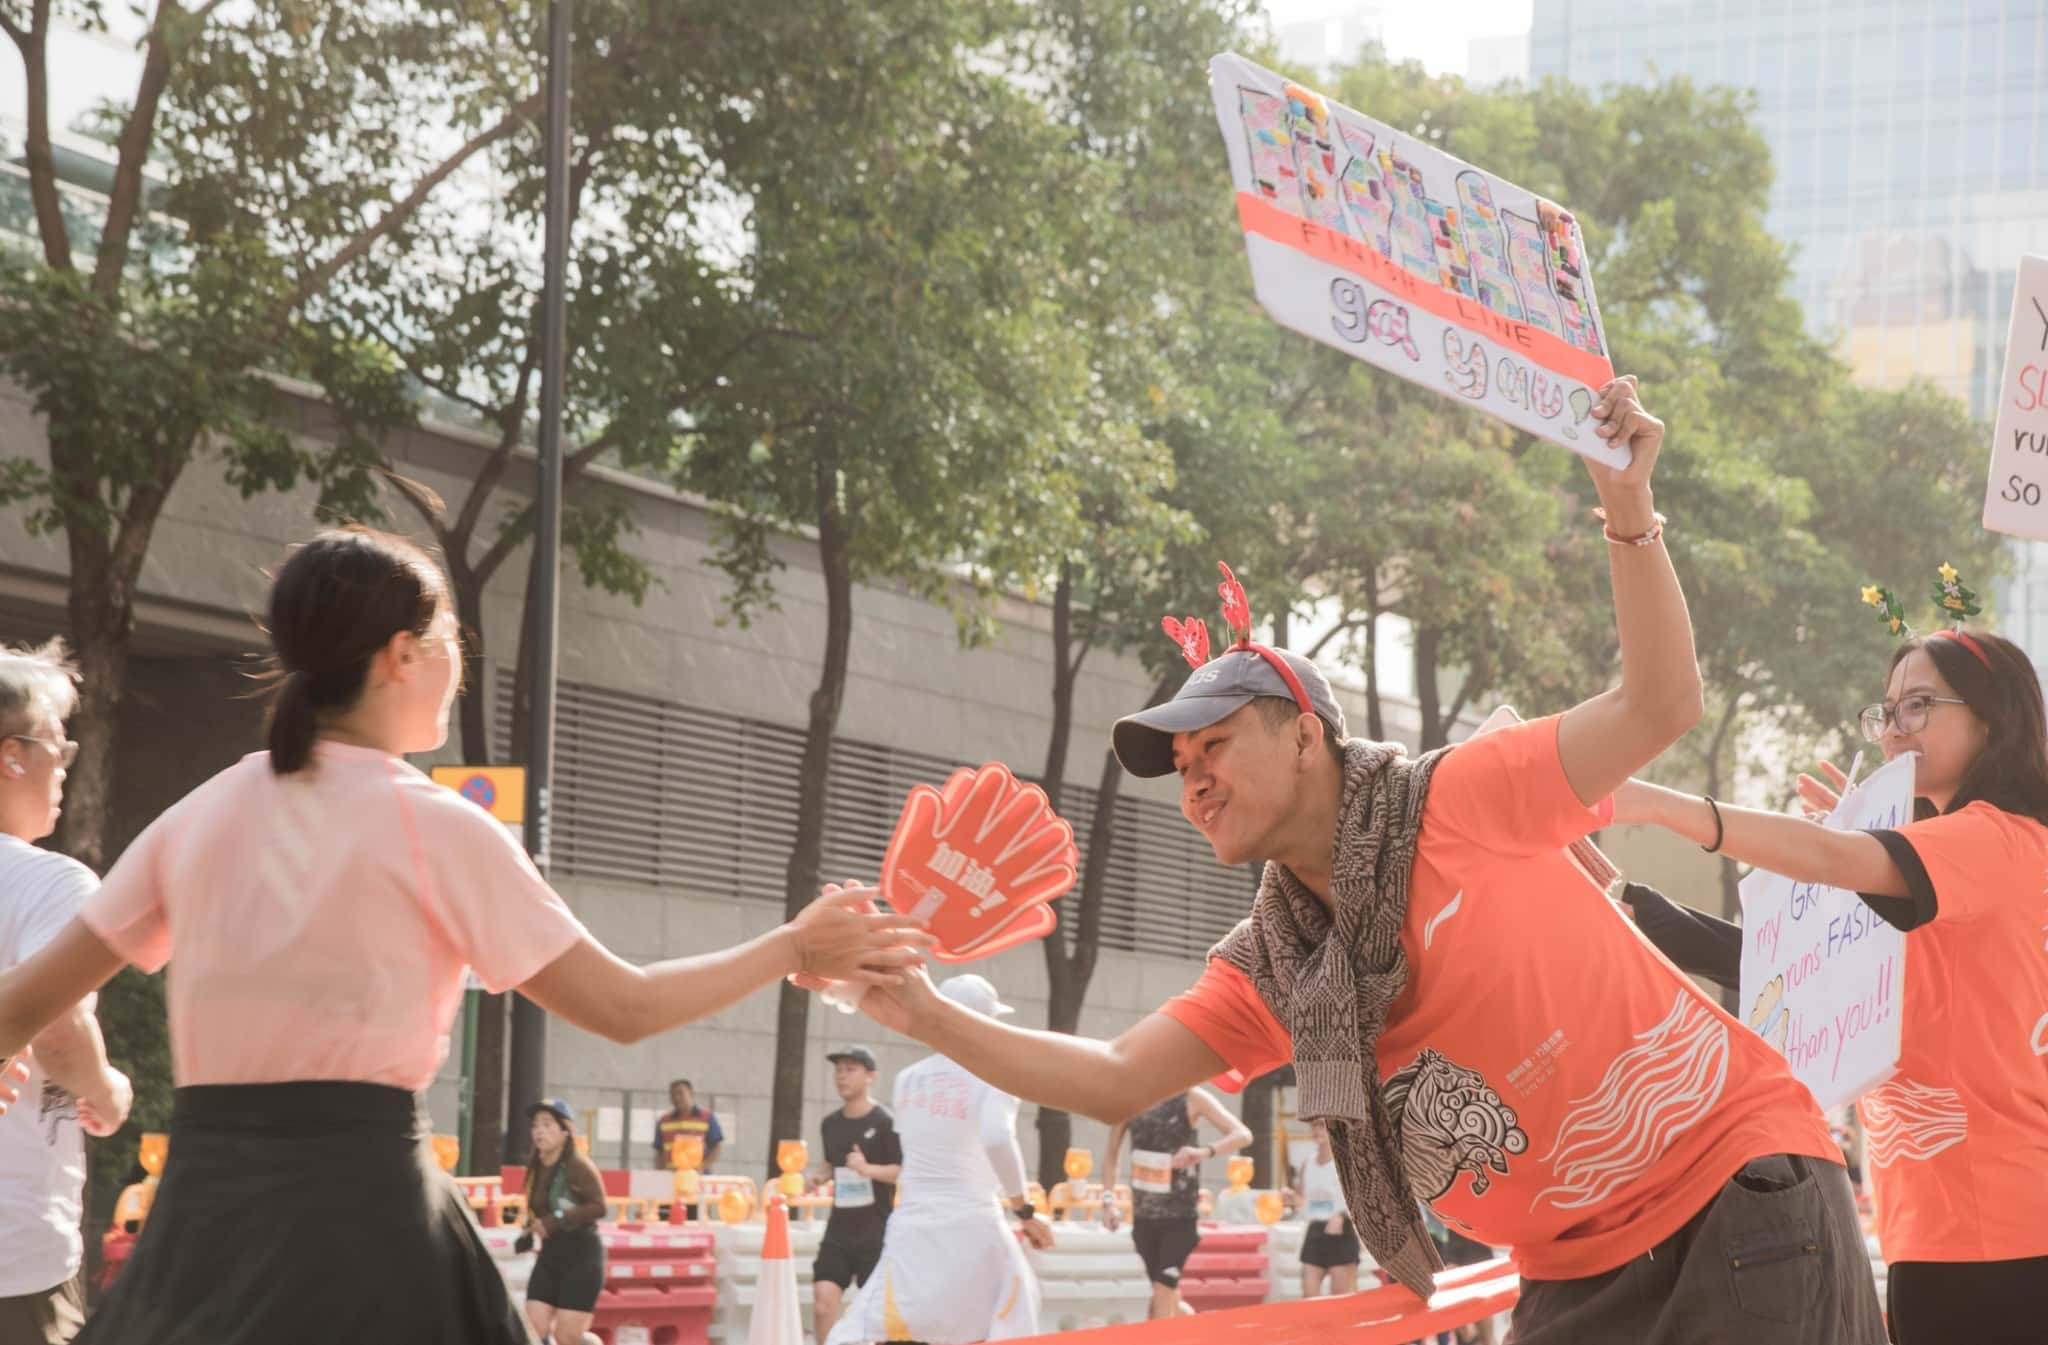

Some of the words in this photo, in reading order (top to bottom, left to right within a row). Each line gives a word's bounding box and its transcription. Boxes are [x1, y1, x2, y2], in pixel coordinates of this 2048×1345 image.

[1330, 277, 1420, 362] ga
[1456, 298, 1532, 349] LINE
[2013, 428, 2048, 456] ru
[1785, 941, 1821, 993] runs
[1788, 1013, 1829, 1069] than
